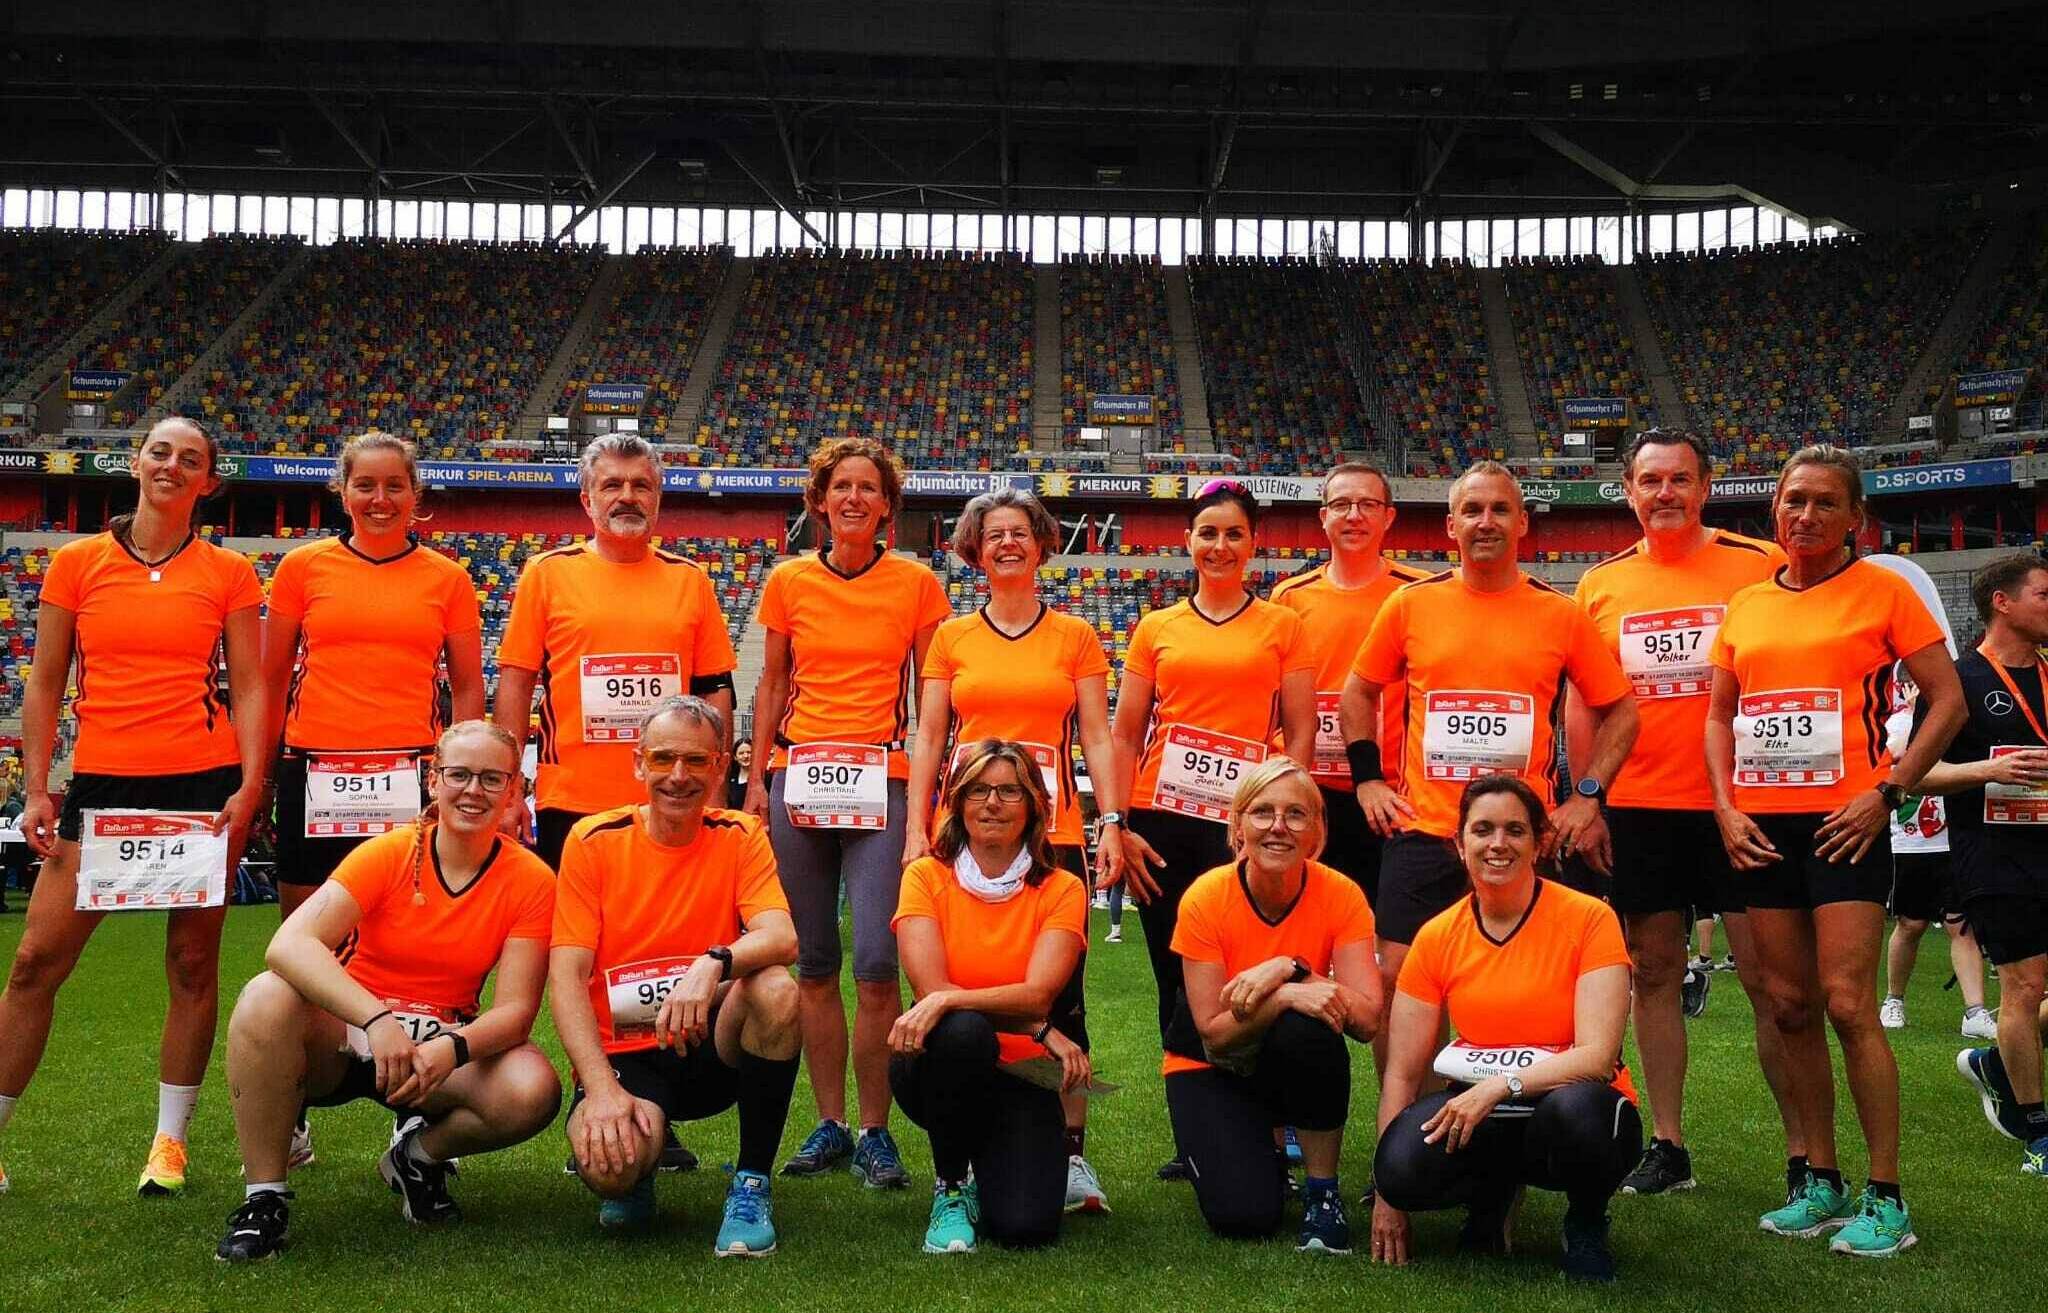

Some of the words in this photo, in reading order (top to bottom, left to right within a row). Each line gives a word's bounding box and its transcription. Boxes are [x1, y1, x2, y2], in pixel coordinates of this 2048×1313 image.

[1093, 400, 1137, 410] Schumacher
[1565, 404, 1610, 414] Schumacher
[0, 455, 37, 467] RKUR
[274, 463, 337, 477] Welcome
[417, 467, 464, 481] ERKUR
[467, 470, 554, 483] SPIEL-ARENA
[670, 474, 693, 486] der
[715, 476, 772, 488] MERKUR
[778, 476, 806, 488] SPIE
[1079, 479, 1141, 492] MERKUR
[1875, 468, 1966, 489] D.SPORTS
[1520, 482, 1560, 499] rlsberg
[1644, 630, 1703, 654] 9517
[1656, 652, 1691, 664] Volker
[606, 677, 662, 699] 9516
[1447, 715, 1507, 737] 9505
[1753, 715, 1813, 738] 9513
[1462, 738, 1489, 746] MALTE
[1764, 738, 1789, 749] Elke
[1183, 751, 1240, 781] 9515
[333, 774, 392, 793] 9511
[807, 766, 864, 786] 9507
[348, 794, 379, 802] SOPHIA
[813, 787, 857, 795] CHRISTIANE
[119, 839, 186, 862] 9514
[638, 977, 684, 1005] 95
[1465, 1050, 1535, 1068] 9506
